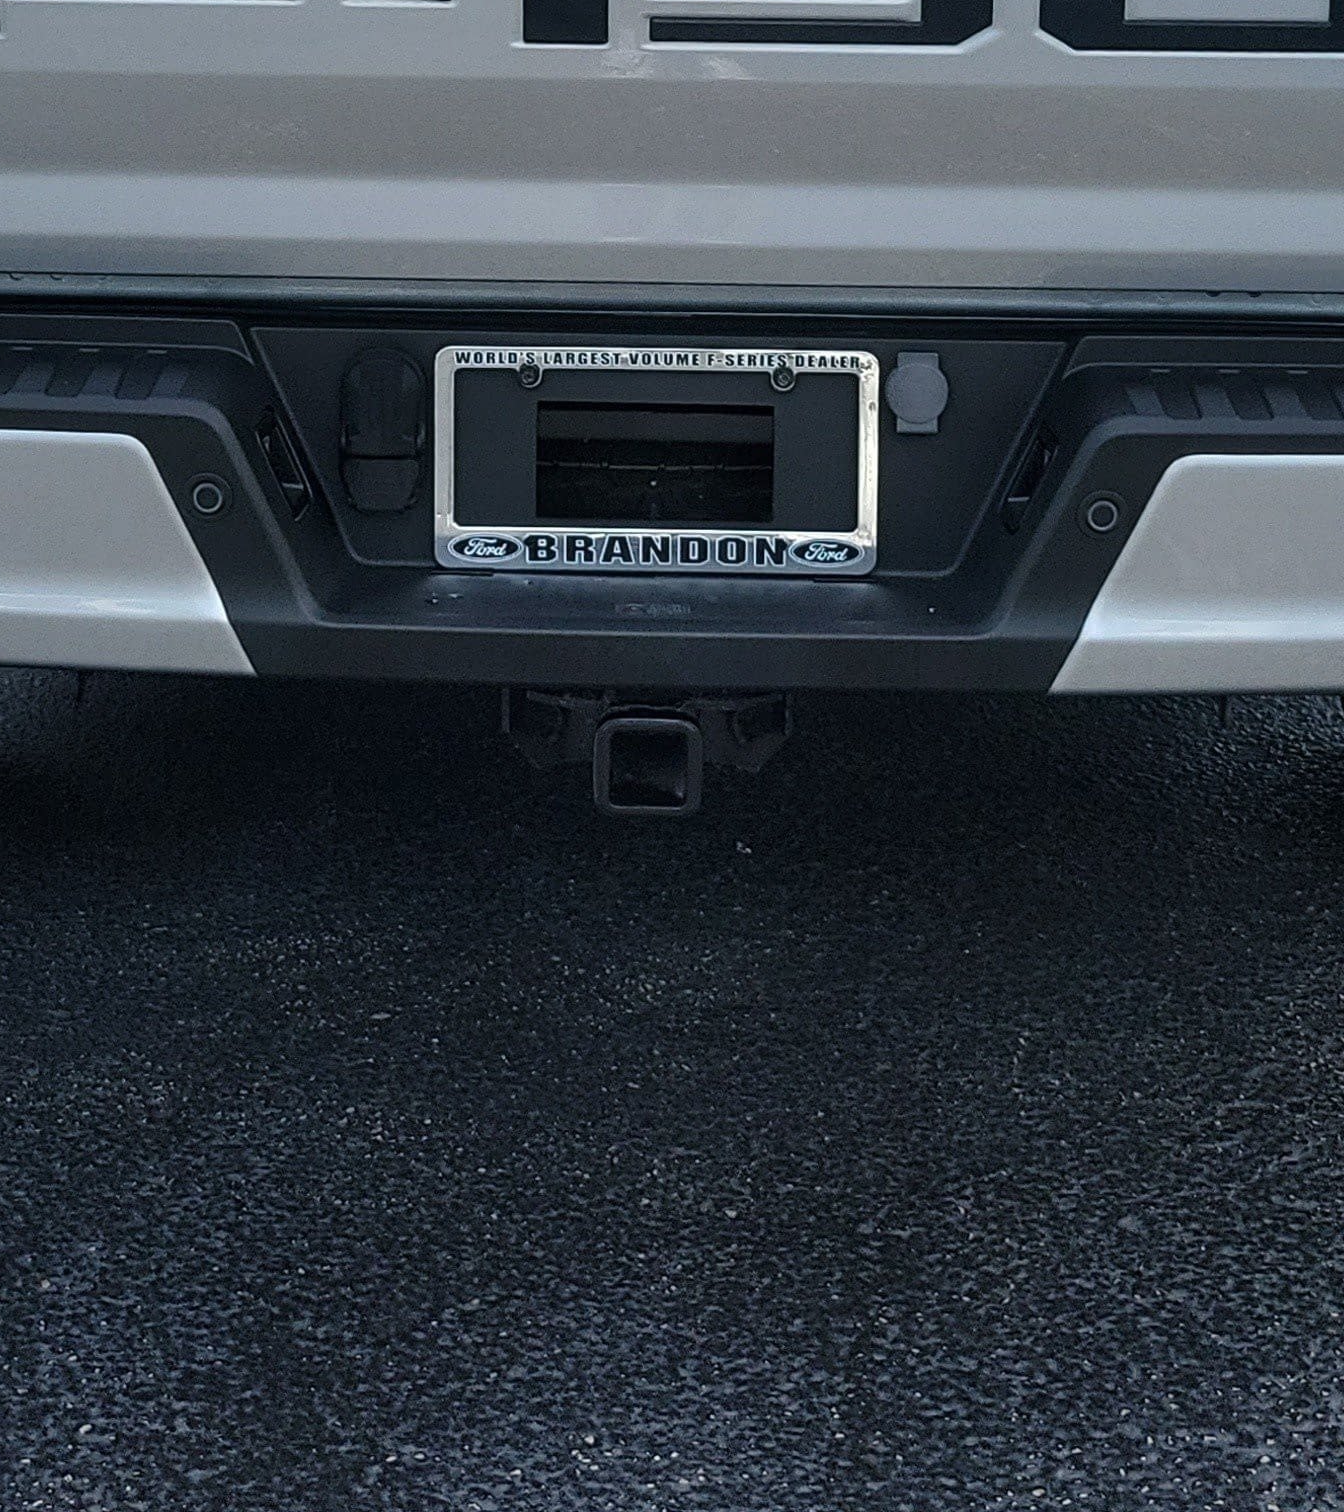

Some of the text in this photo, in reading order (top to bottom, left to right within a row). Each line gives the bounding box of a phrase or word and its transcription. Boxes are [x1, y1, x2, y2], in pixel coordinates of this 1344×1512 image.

[455, 351, 861, 369] WORLD'S LARGEST VOLUME F-SERIES DEALER
[463, 533, 848, 566] Ford BRANDON Ford
